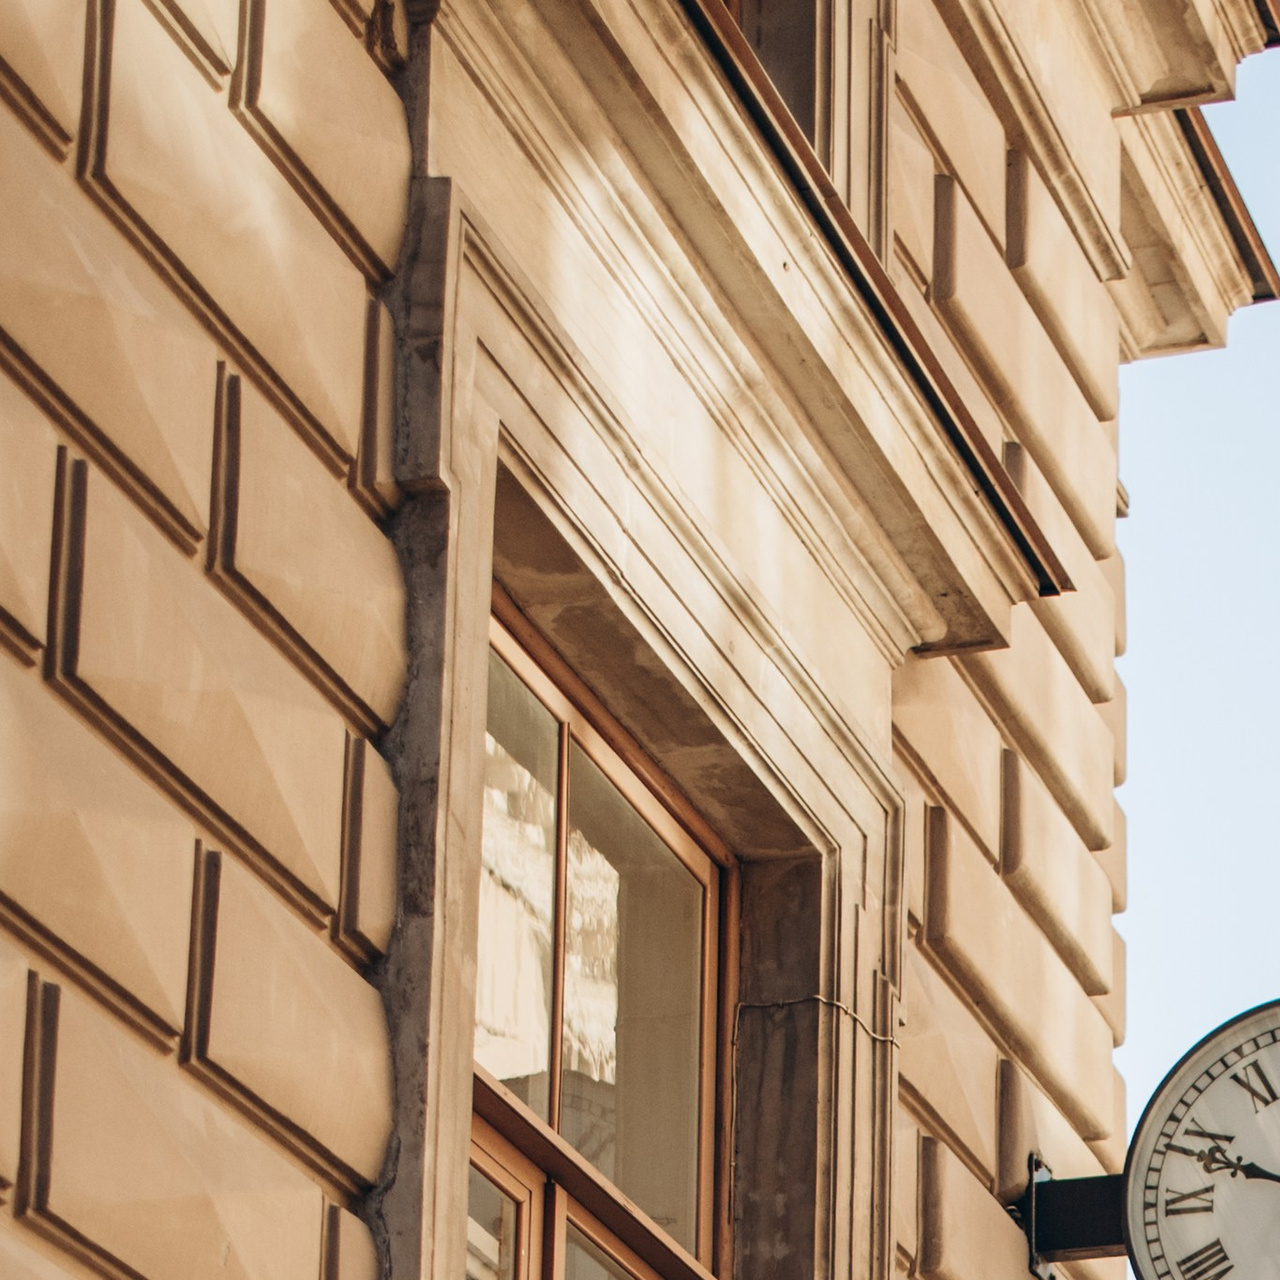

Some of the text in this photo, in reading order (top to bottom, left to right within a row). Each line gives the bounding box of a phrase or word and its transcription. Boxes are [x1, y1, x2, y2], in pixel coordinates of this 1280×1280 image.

[1230, 1059, 1280, 1114] XI
[1183, 1118, 1236, 1150] X
[1165, 1184, 1215, 1217] IX
